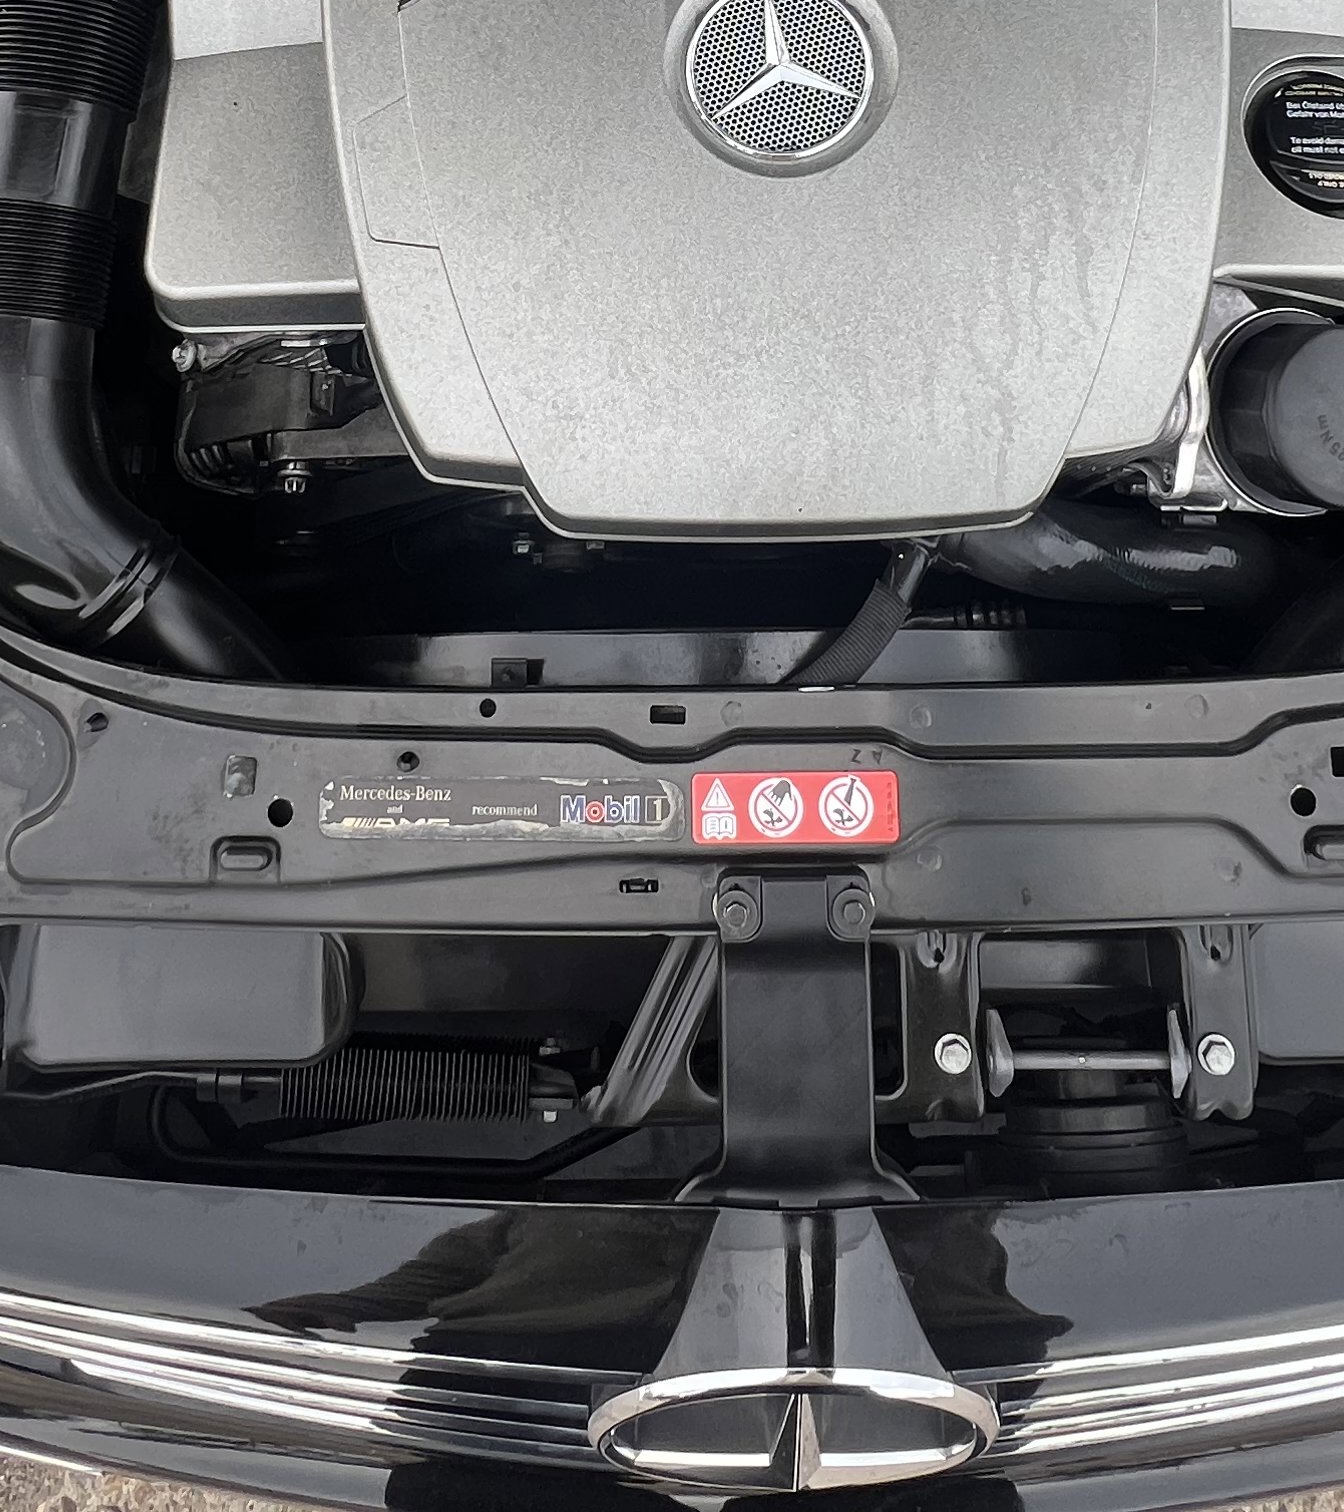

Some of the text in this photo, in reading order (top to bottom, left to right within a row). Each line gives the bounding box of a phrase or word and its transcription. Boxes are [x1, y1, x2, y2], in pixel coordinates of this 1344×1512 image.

[339, 785, 452, 801] Mercedes-Benz
[386, 803, 403, 814] and
[471, 803, 539, 816] recommend
[560, 795, 641, 824] Mobil
